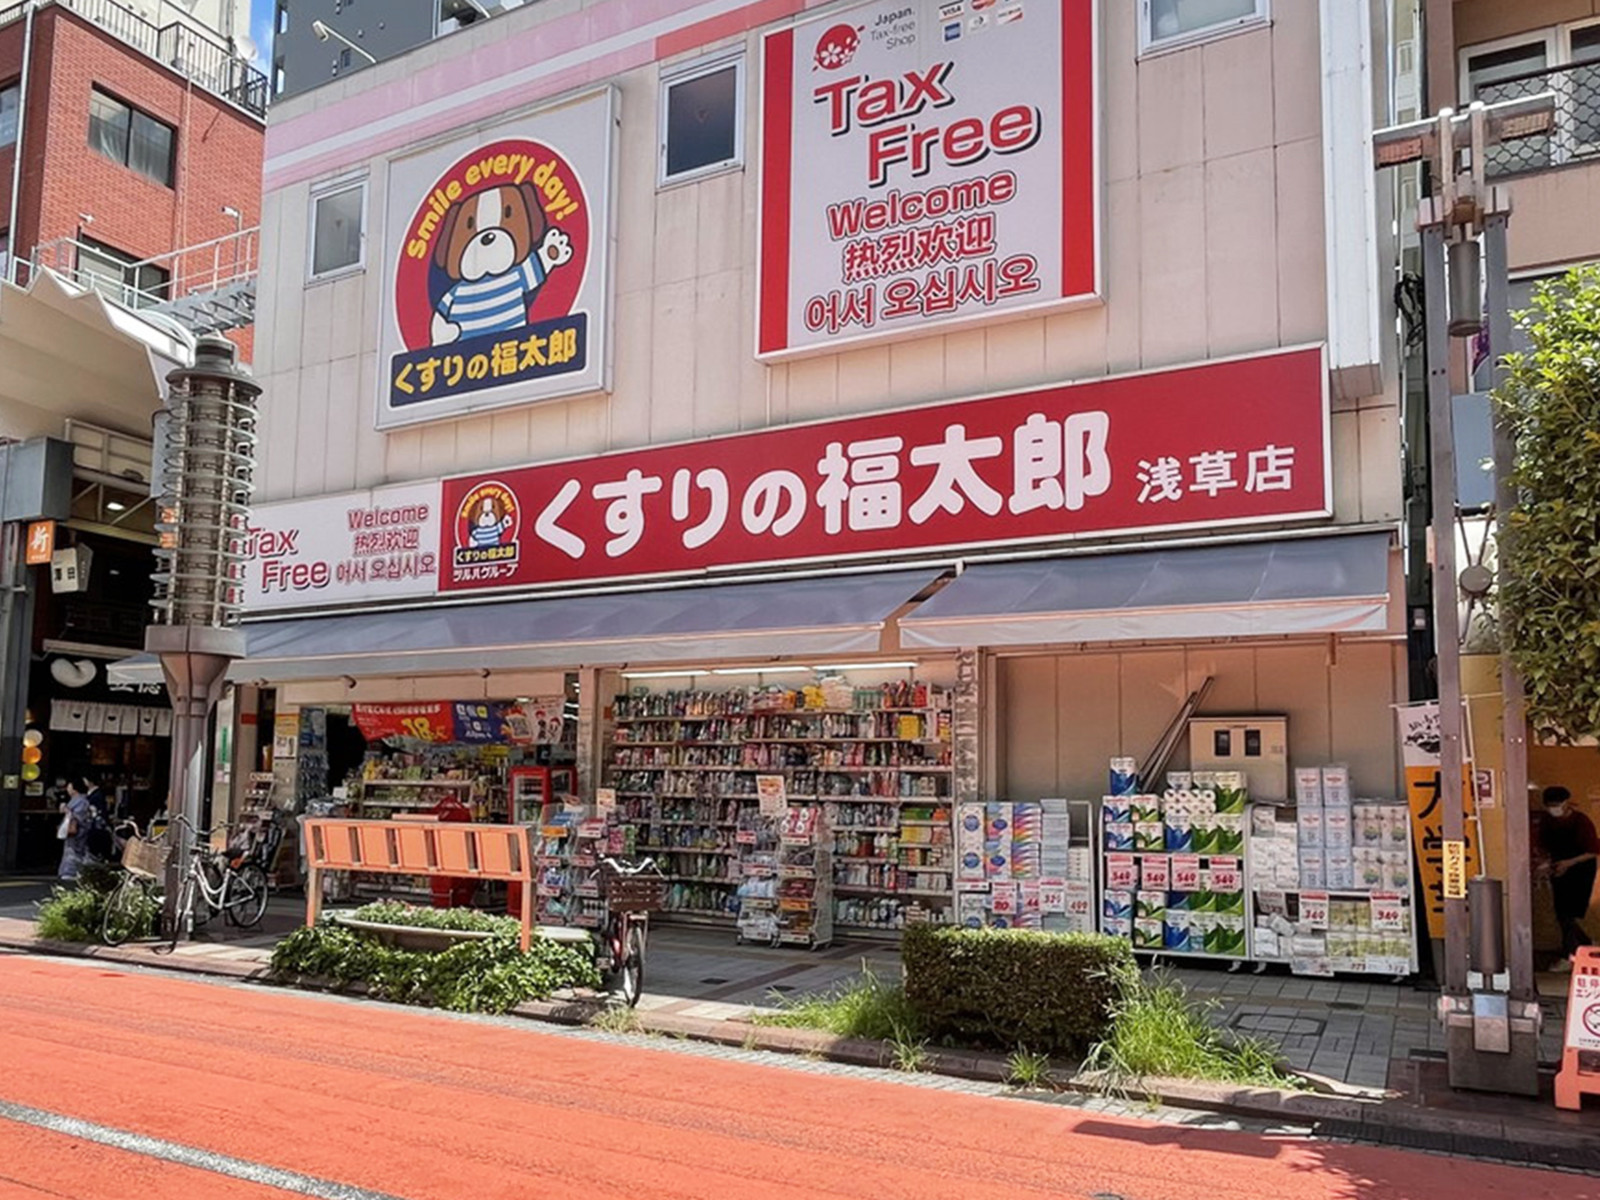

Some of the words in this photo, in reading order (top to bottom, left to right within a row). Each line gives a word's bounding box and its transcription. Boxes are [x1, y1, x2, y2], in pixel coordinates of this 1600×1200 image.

[871, 20, 916, 41] Tax-free
[886, 34, 916, 50] Shop
[813, 61, 954, 136] Tax
[868, 103, 1041, 188] Free
[407, 180, 462, 259] Smile
[465, 153, 535, 184] every
[533, 160, 579, 221] day!
[827, 170, 1014, 241] Welcome
[843, 212, 996, 283] 热烈欢迎
[805, 286, 875, 334] 어서
[883, 254, 1041, 318] 오십시오
[394, 327, 577, 394] くすりの福太郎
[348, 504, 429, 530] Welcome
[533, 410, 1112, 558] くすりの福太郎
[1136, 444, 1297, 505] 浅草店
[261, 560, 330, 593] Free
[336, 560, 366, 586] 어서
[370, 552, 437, 581] 오십시오
